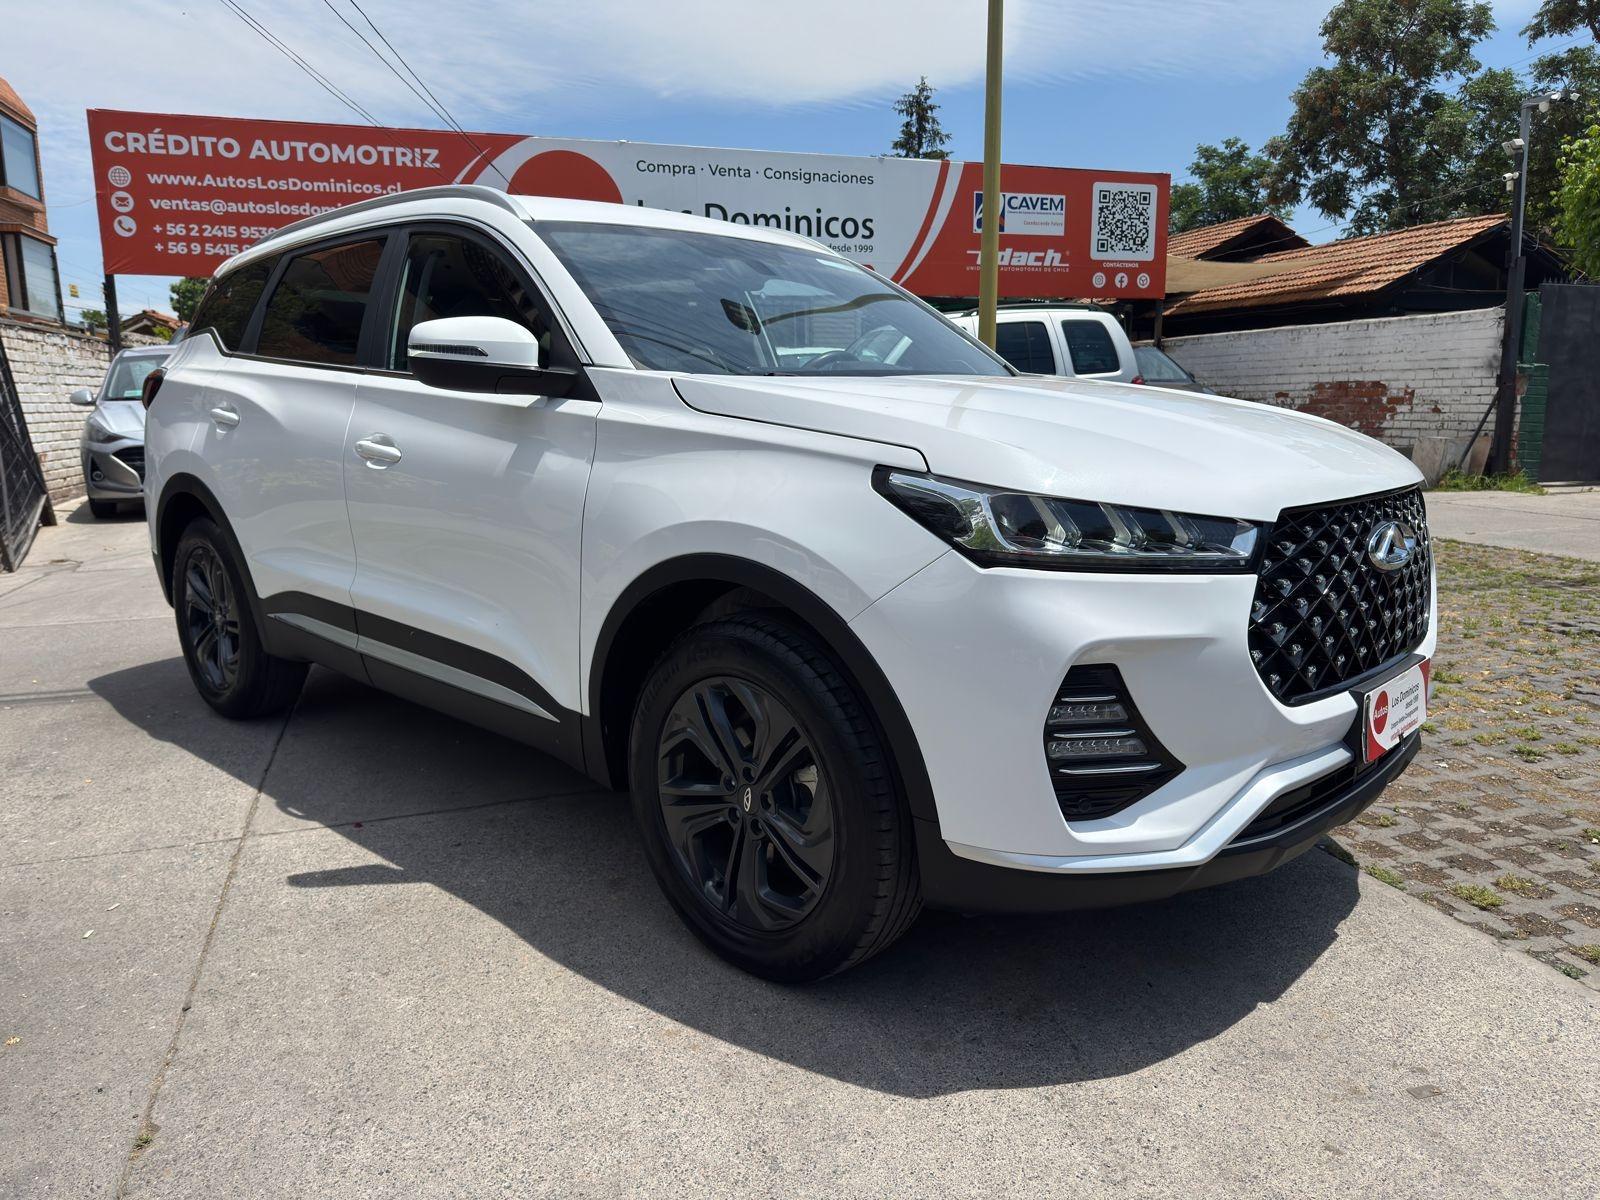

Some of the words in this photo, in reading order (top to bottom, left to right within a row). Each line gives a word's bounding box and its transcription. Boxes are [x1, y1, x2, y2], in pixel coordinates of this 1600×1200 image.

[104, 128, 241, 158] CRÉDITO
[249, 139, 440, 169] AUTOMOTRIZ
[636, 159, 696, 177] Compra
[708, 164, 751, 178] Venta
[764, 167, 874, 185] Consignaciones
[146, 173, 401, 195] www.AutosLosDominicos.cl
[1007, 195, 1064, 212] CAVEM
[166, 223, 186, 236] 56
[189, 225, 200, 237] 2
[202, 225, 238, 238] 2415
[168, 242, 188, 254] 56
[190, 243, 201, 255] 9
[205, 243, 239, 257] 5415
[854, 244, 874, 253] 1999
